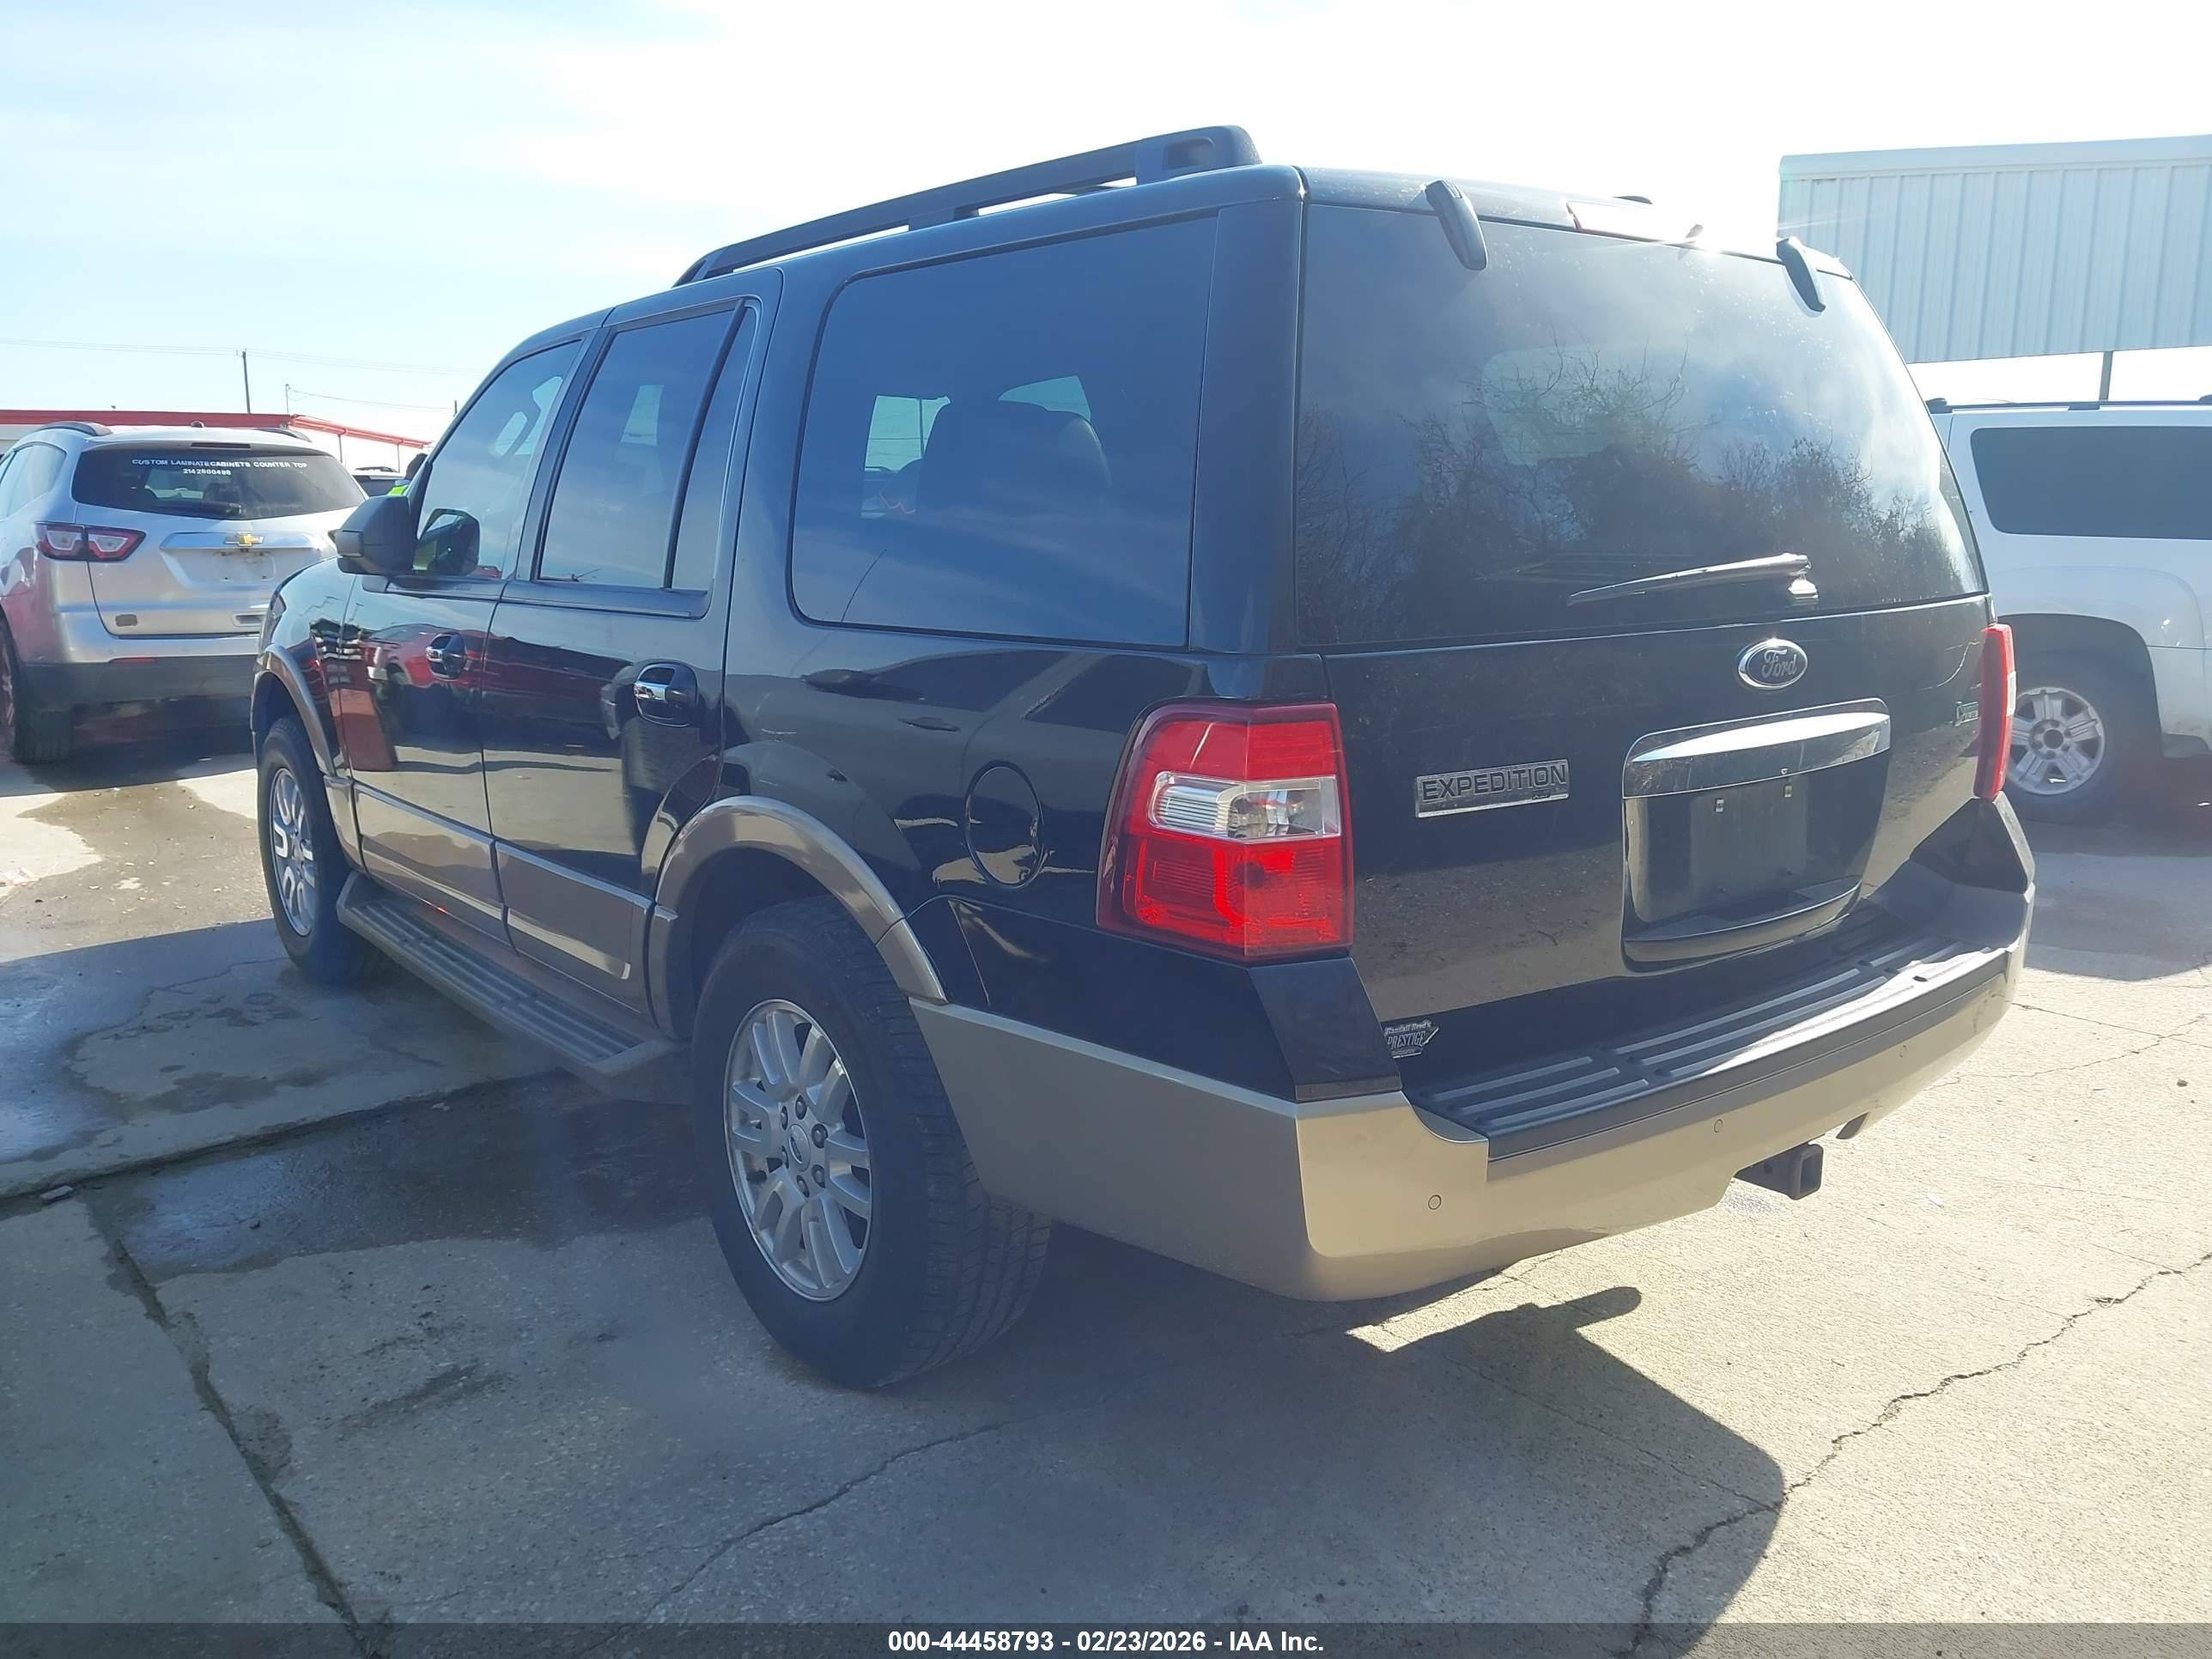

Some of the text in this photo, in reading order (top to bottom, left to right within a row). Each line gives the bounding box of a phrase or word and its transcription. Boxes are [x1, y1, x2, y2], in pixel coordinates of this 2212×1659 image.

[1761, 648, 1797, 678] Ford
[1422, 763, 1567, 802] EXPEDITION
[1387, 1030, 1426, 1050] PRESTIGE
